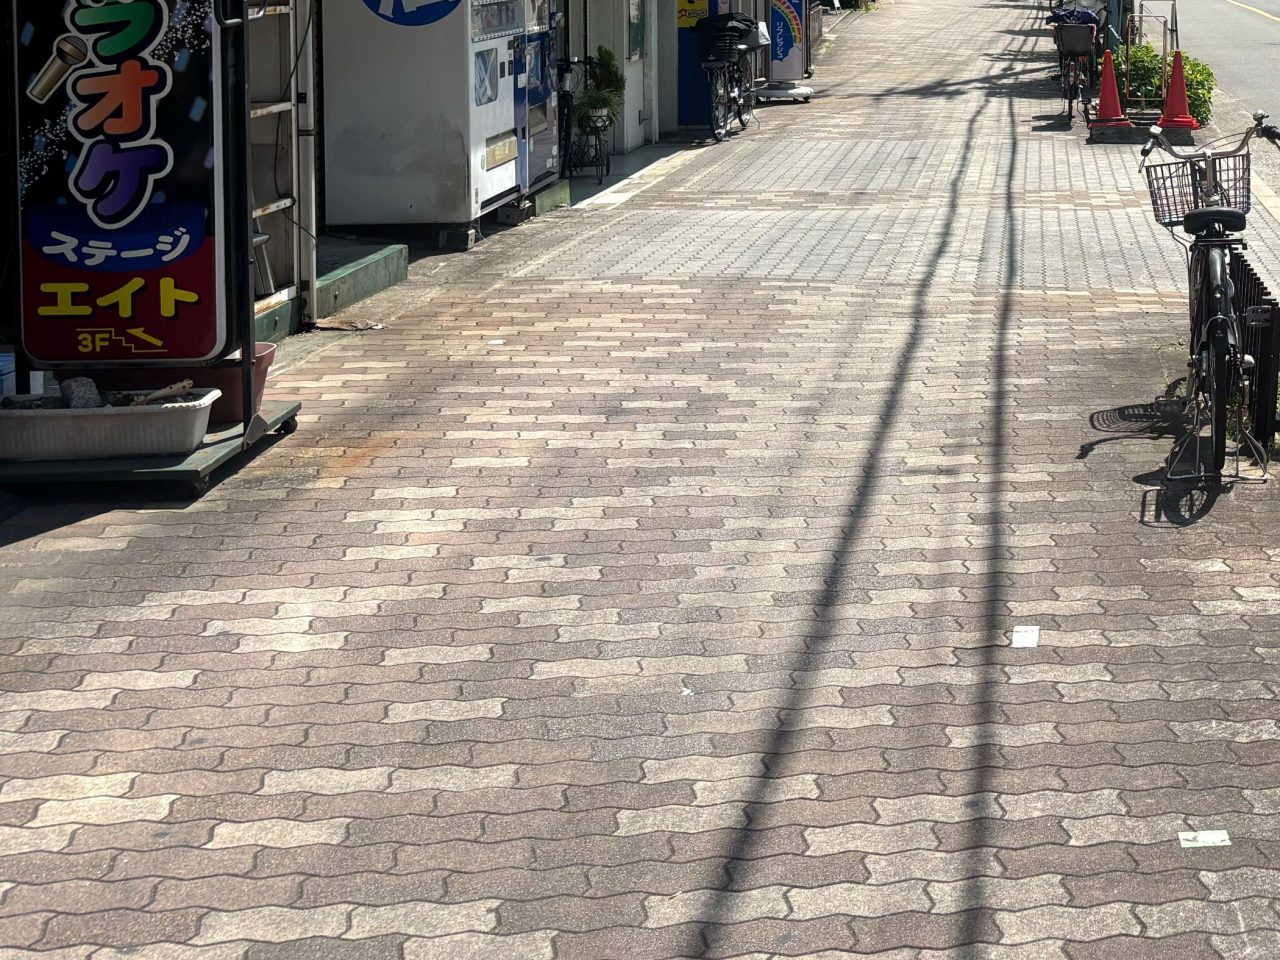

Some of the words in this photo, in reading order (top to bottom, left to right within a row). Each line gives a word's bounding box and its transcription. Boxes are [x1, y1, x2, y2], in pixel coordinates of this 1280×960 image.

[42, 227, 190, 266] ステージ
[37, 277, 198, 317] エイト
[78, 333, 110, 352] 3F
